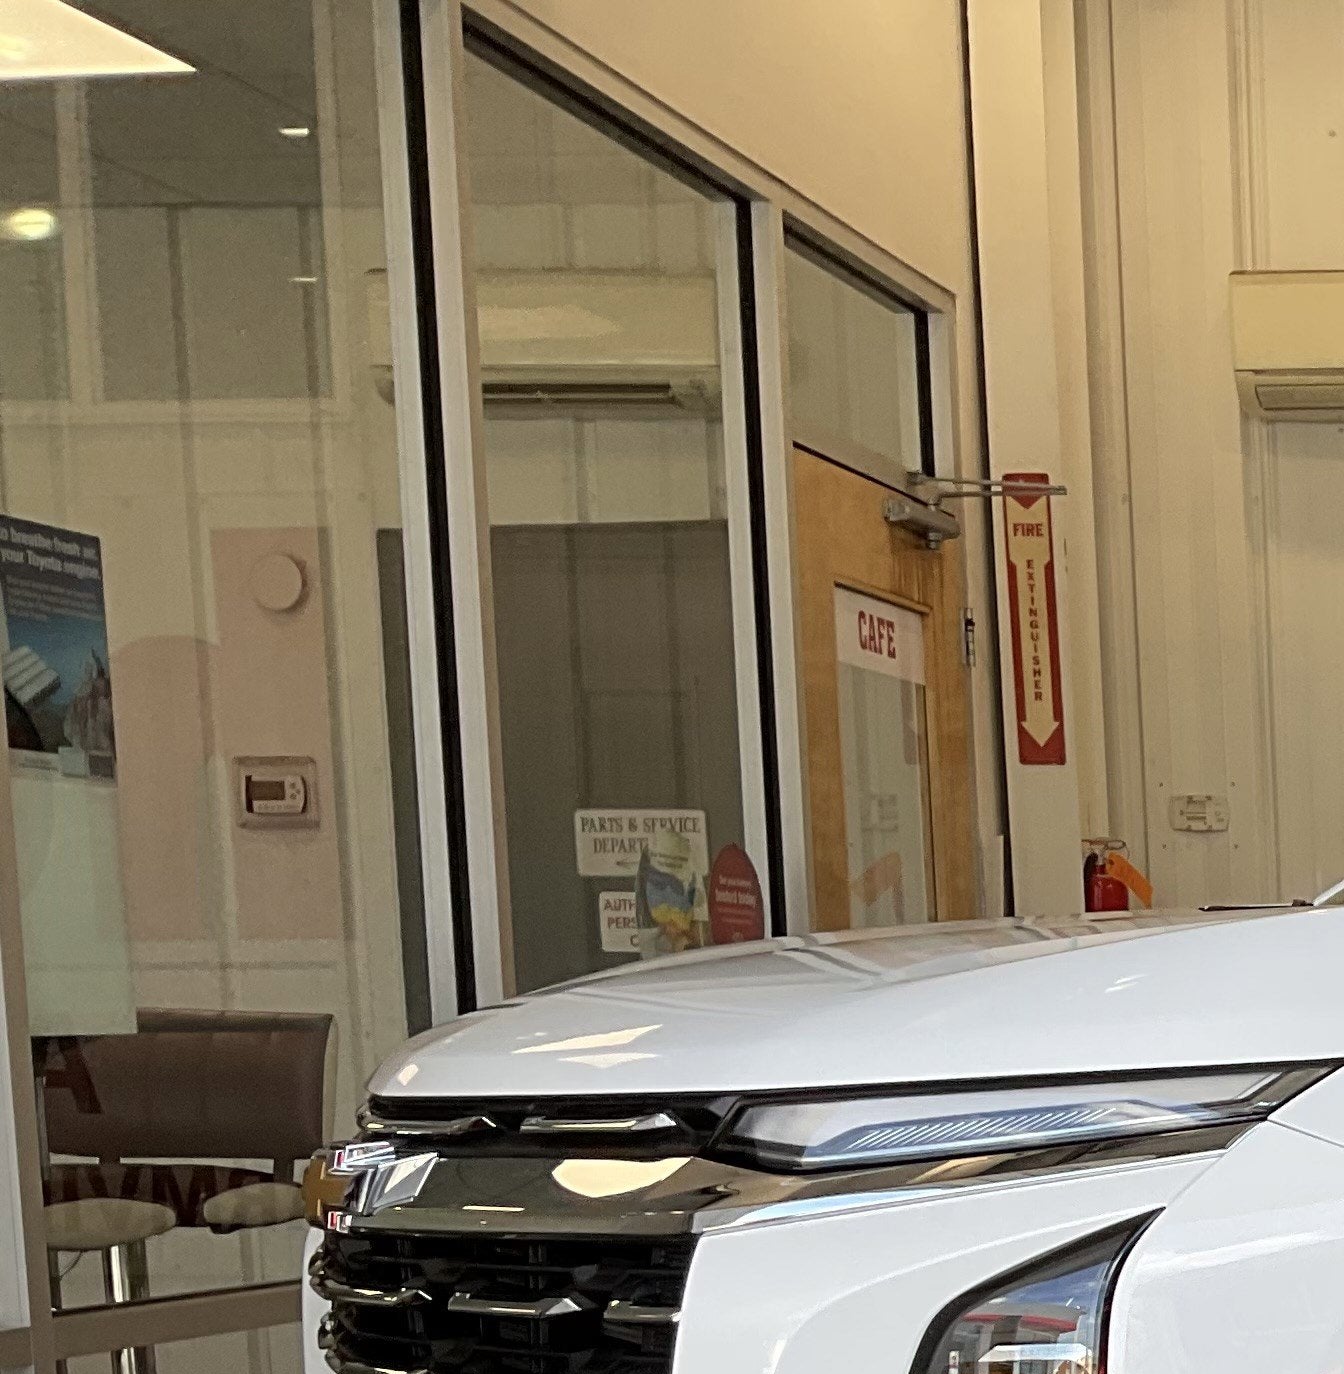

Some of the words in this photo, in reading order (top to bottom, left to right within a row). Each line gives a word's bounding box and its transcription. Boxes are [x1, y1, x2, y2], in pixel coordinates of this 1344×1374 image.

[1012, 522, 1044, 537] FIRE
[858, 610, 896, 659] CAFE
[1026, 559, 1043, 701] EXTINGUISHER
[580, 816, 623, 833] PARTS
[628, 817, 638, 832] &
[643, 816, 700, 833] SERVICE
[594, 837, 649, 854] DEPART
[604, 898, 636, 911] AUTH
[607, 916, 636, 929] PERS
